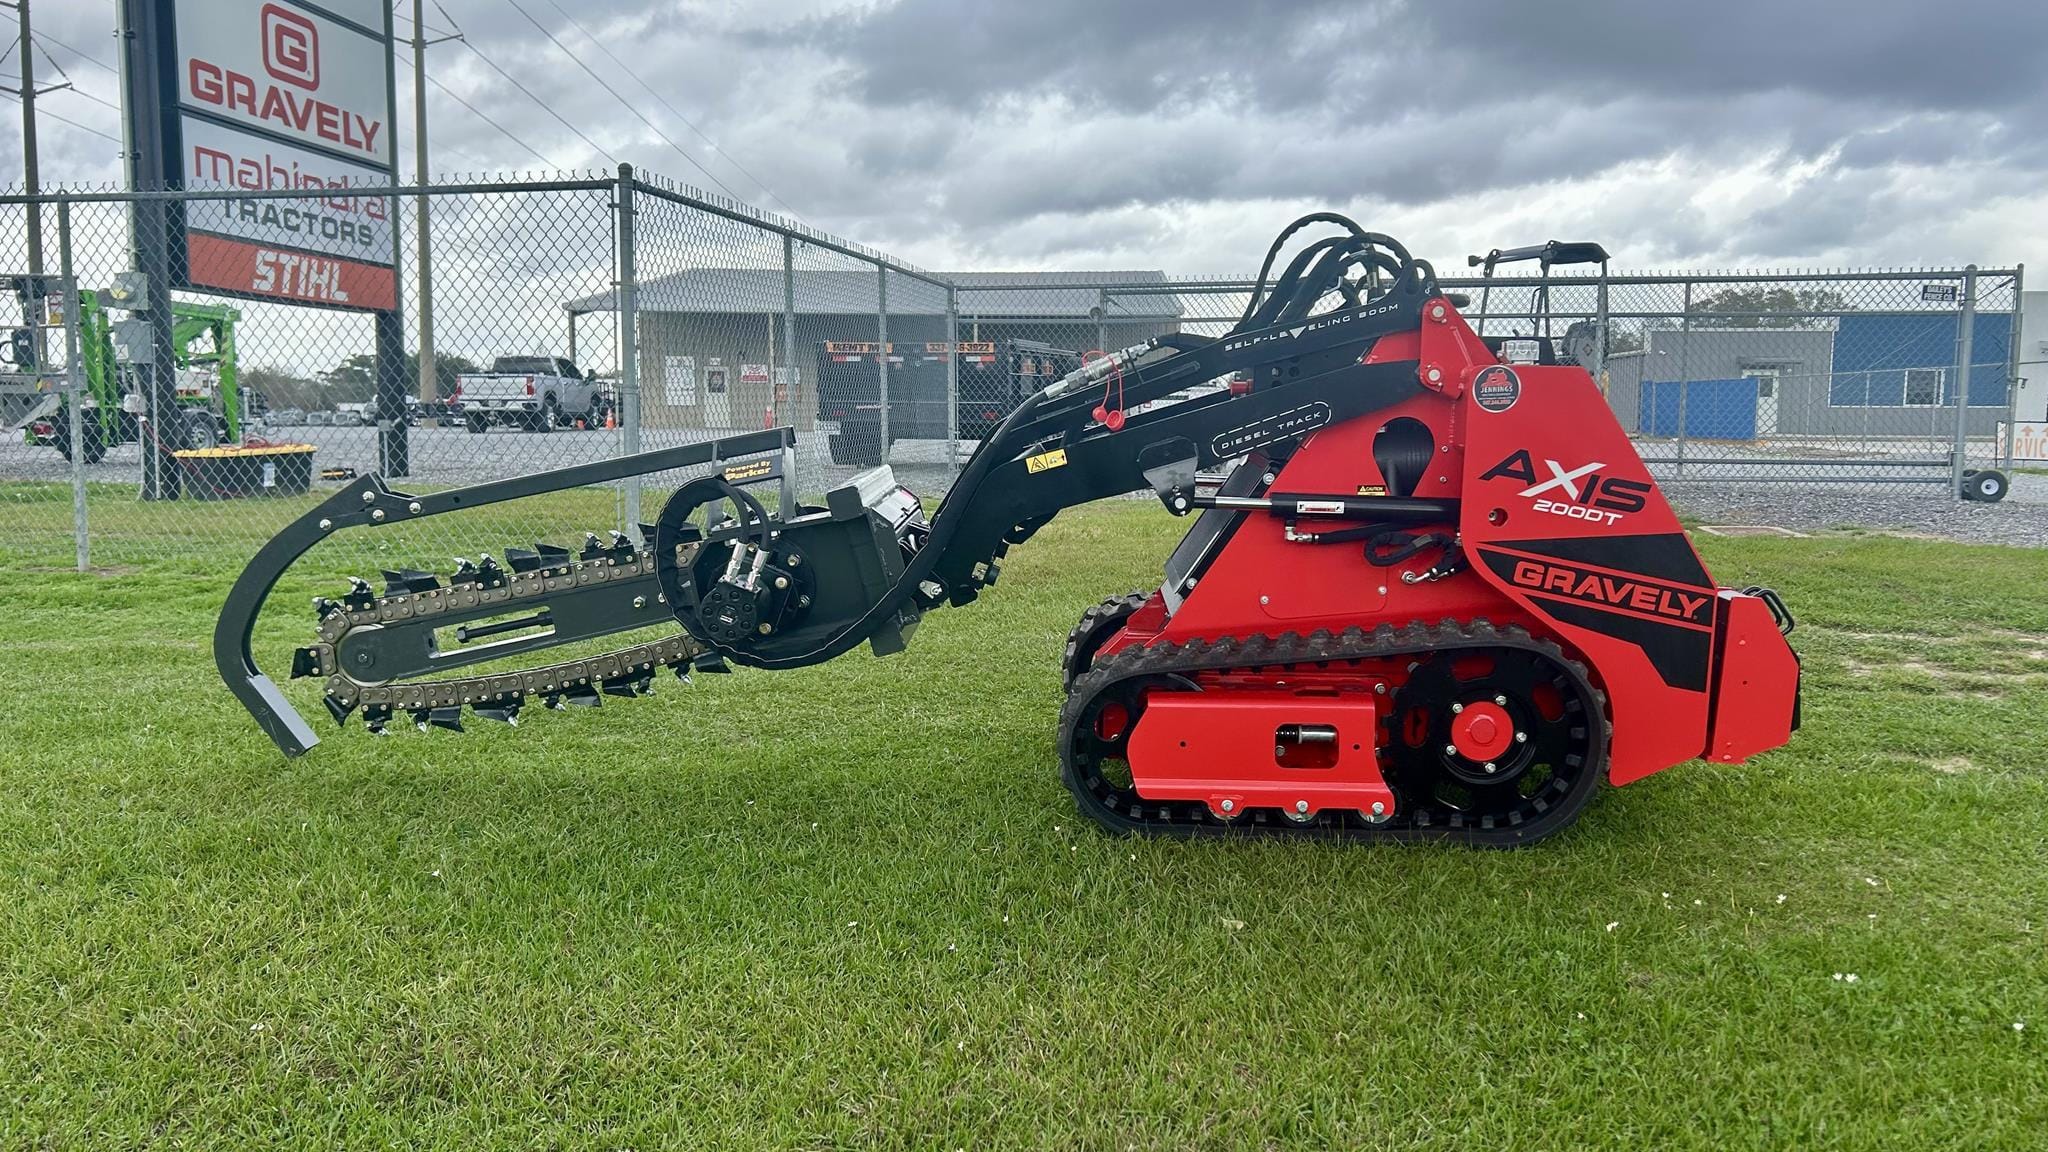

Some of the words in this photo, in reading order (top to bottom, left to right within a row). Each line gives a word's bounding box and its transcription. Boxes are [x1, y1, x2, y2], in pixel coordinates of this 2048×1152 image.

[189, 57, 381, 153] GRAVELY
[194, 145, 386, 220] mahindra
[224, 194, 373, 246] TRACTORS
[252, 249, 349, 302] STIHL
[1358, 303, 1399, 319] BOOM
[1480, 386, 1513, 394] JENNINGS
[1221, 429, 1270, 450] DIESEL
[1277, 411, 1321, 430] TRACK
[725, 461, 760, 474] Powered
[760, 460, 772, 468] By
[725, 466, 772, 481] Parker
[1478, 448, 1653, 513] AXIS
[1532, 498, 1624, 526] 200DT
[1512, 560, 1709, 620] GRAVELY
